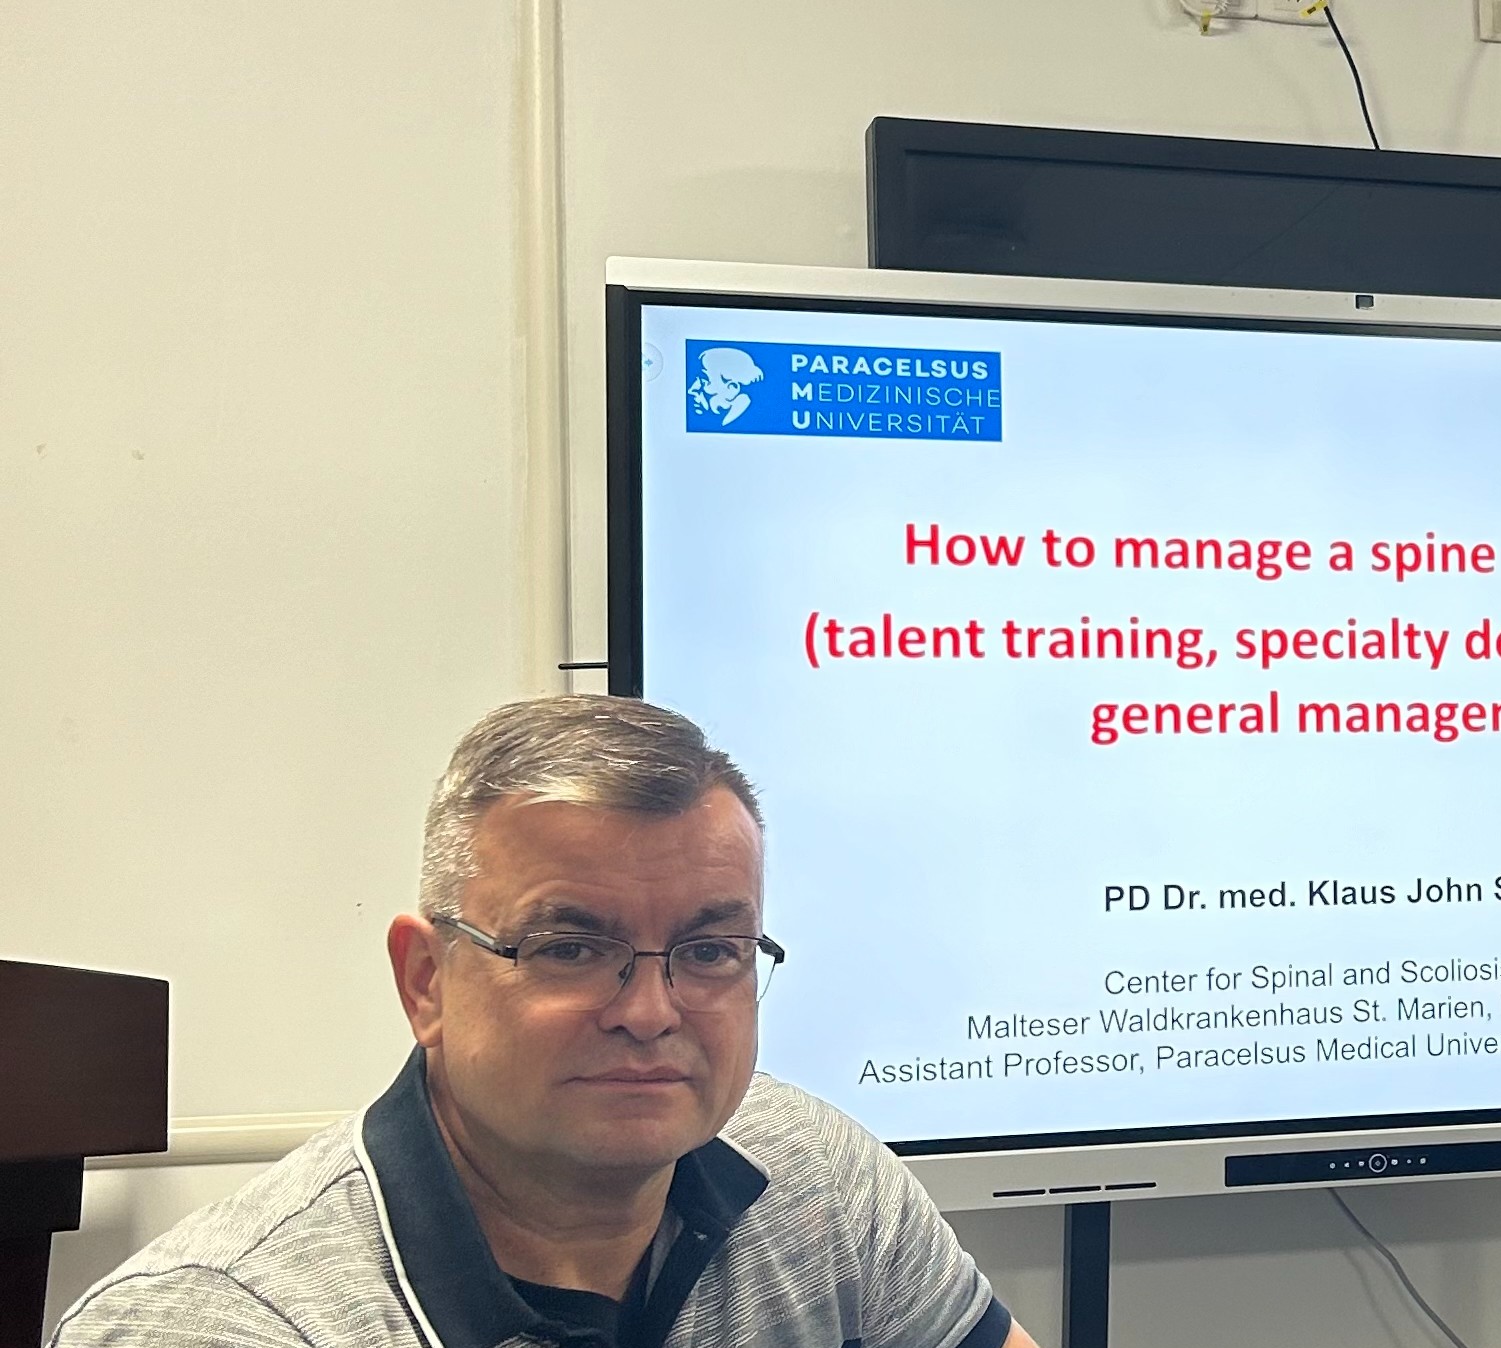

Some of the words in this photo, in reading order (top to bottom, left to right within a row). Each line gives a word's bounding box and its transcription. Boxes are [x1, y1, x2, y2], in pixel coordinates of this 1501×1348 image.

[791, 354, 988, 379] PARACELSUS
[791, 382, 1000, 407] MEDIZINISCHE
[793, 410, 985, 436] UNIVERSITÄT
[907, 524, 1024, 566] How
[1042, 530, 1094, 567] to
[1116, 538, 1311, 580] manage
[1330, 542, 1352, 571] a
[1372, 532, 1495, 582] spine
[806, 612, 984, 668] (talent
[1002, 617, 1217, 669] training,
[1237, 618, 1449, 669] specialty
[1092, 691, 1278, 745] general
[1106, 886, 1149, 911] PD
[1164, 885, 1205, 910] Dr.
[1220, 882, 1295, 908] med.
[1309, 880, 1395, 906] Klaus
[1407, 877, 1481, 903] John
[1105, 971, 1197, 994] Center
[1206, 967, 1242, 990] for
[1252, 963, 1331, 994] Spinal
[1344, 961, 1389, 985] and
[968, 1014, 1090, 1039] Malteser
[1100, 1003, 1342, 1033] Waldkrankenhaus
[1353, 999, 1385, 1022] St.
[1398, 996, 1491, 1020] Marien,
[859, 1056, 993, 1084] Assistant
[1005, 1051, 1143, 1077] Professor,
[1158, 1042, 1305, 1069] Paracelsus
[1317, 1035, 1415, 1061] Medical
